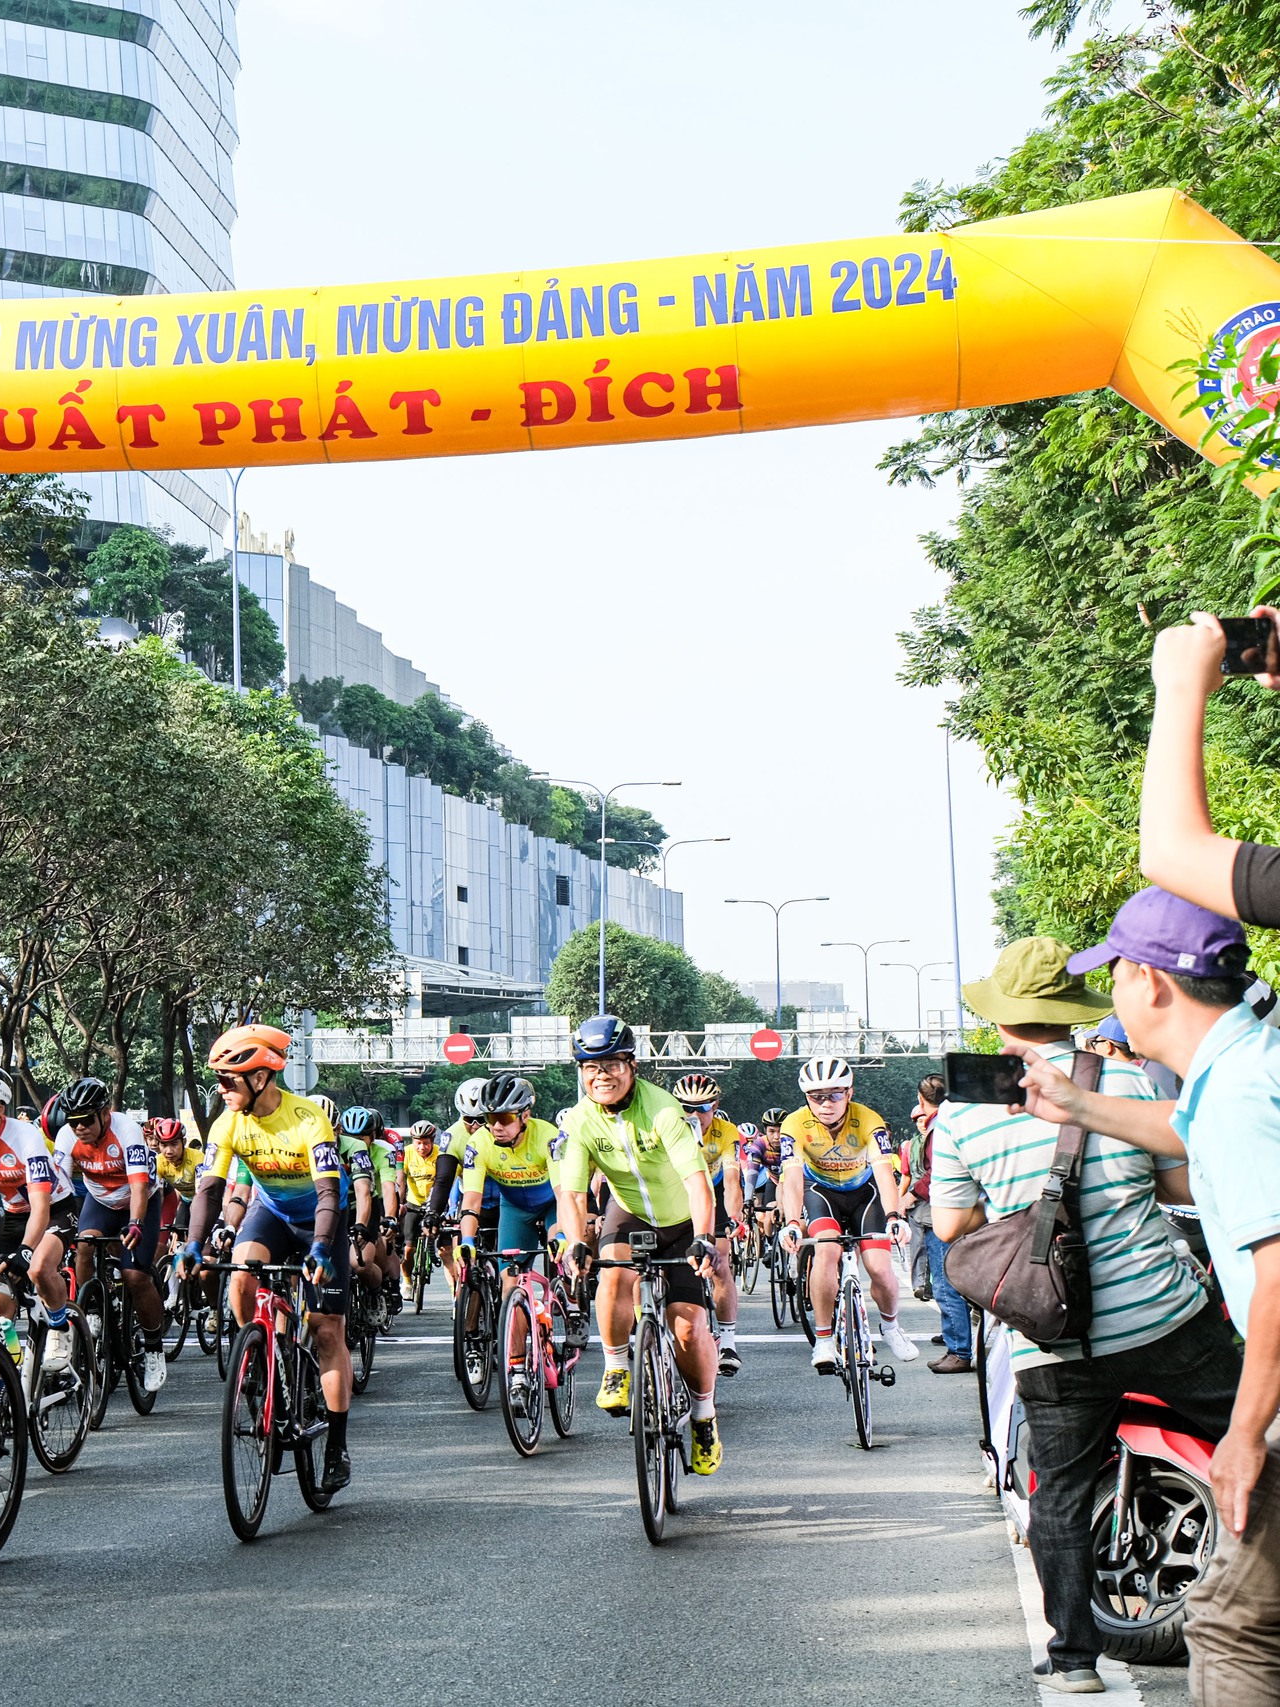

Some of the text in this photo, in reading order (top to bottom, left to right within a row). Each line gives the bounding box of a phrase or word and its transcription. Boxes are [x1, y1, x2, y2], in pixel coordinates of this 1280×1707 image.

[14, 312, 159, 371] MỪNG
[172, 303, 317, 367] XUÂN,
[334, 295, 485, 356] MỪNG
[500, 277, 640, 345] ĐẢNG
[691, 262, 814, 328] NĂM
[830, 248, 959, 314] 2024
[192, 379, 442, 447] PHÁT
[519, 358, 744, 428] ĐÍCH
[877, 1134, 892, 1150] 26
[128, 1148, 146, 1163] 225
[314, 1144, 340, 1168] 276
[30, 1161, 50, 1179] 221
[282, 1160, 310, 1171] VEL
